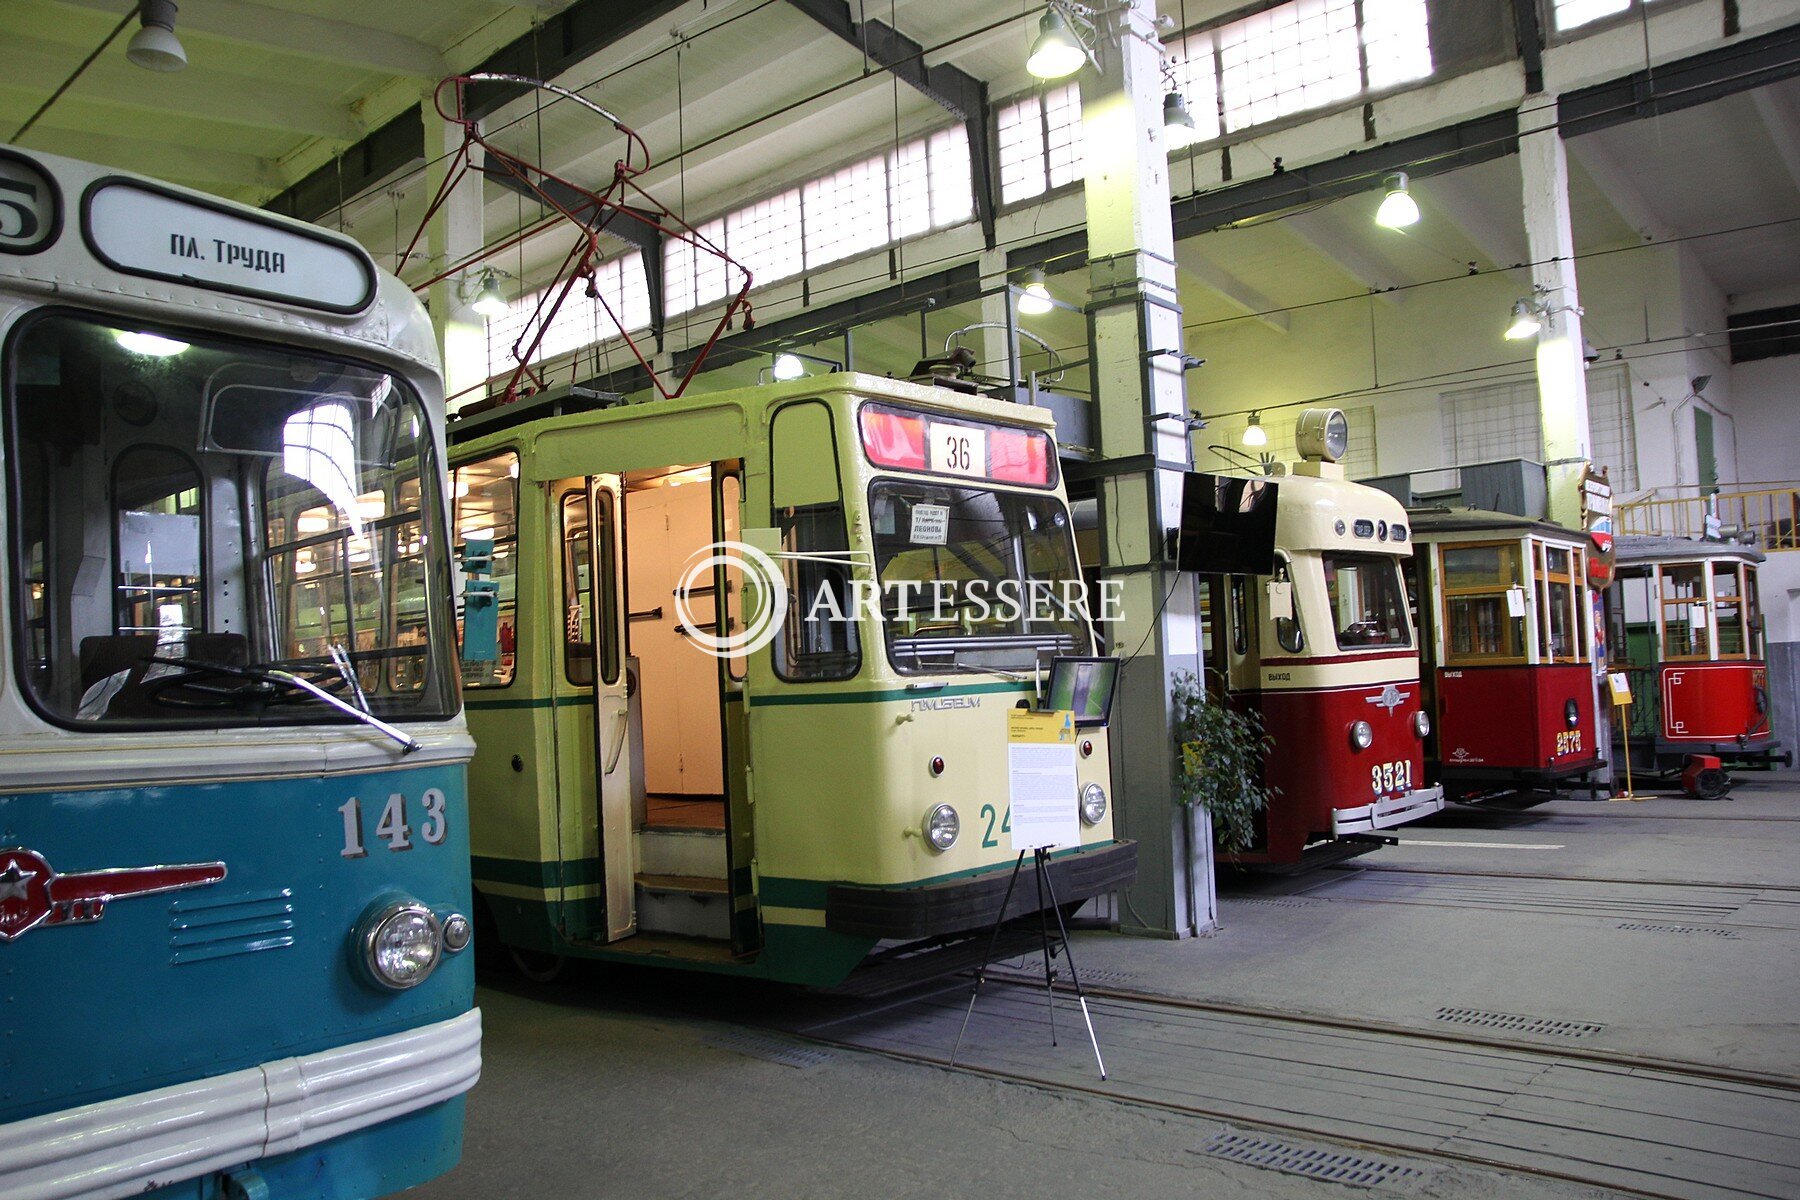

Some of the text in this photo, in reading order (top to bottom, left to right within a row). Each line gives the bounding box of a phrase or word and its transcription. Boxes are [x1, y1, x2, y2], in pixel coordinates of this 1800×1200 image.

[170, 233, 286, 274] ПЛ. ТРУДА
[946, 435, 971, 471] 36
[1268, 672, 1291, 682] ВЫХОД
[1371, 759, 1412, 795] 3521
[338, 787, 447, 859] 143
